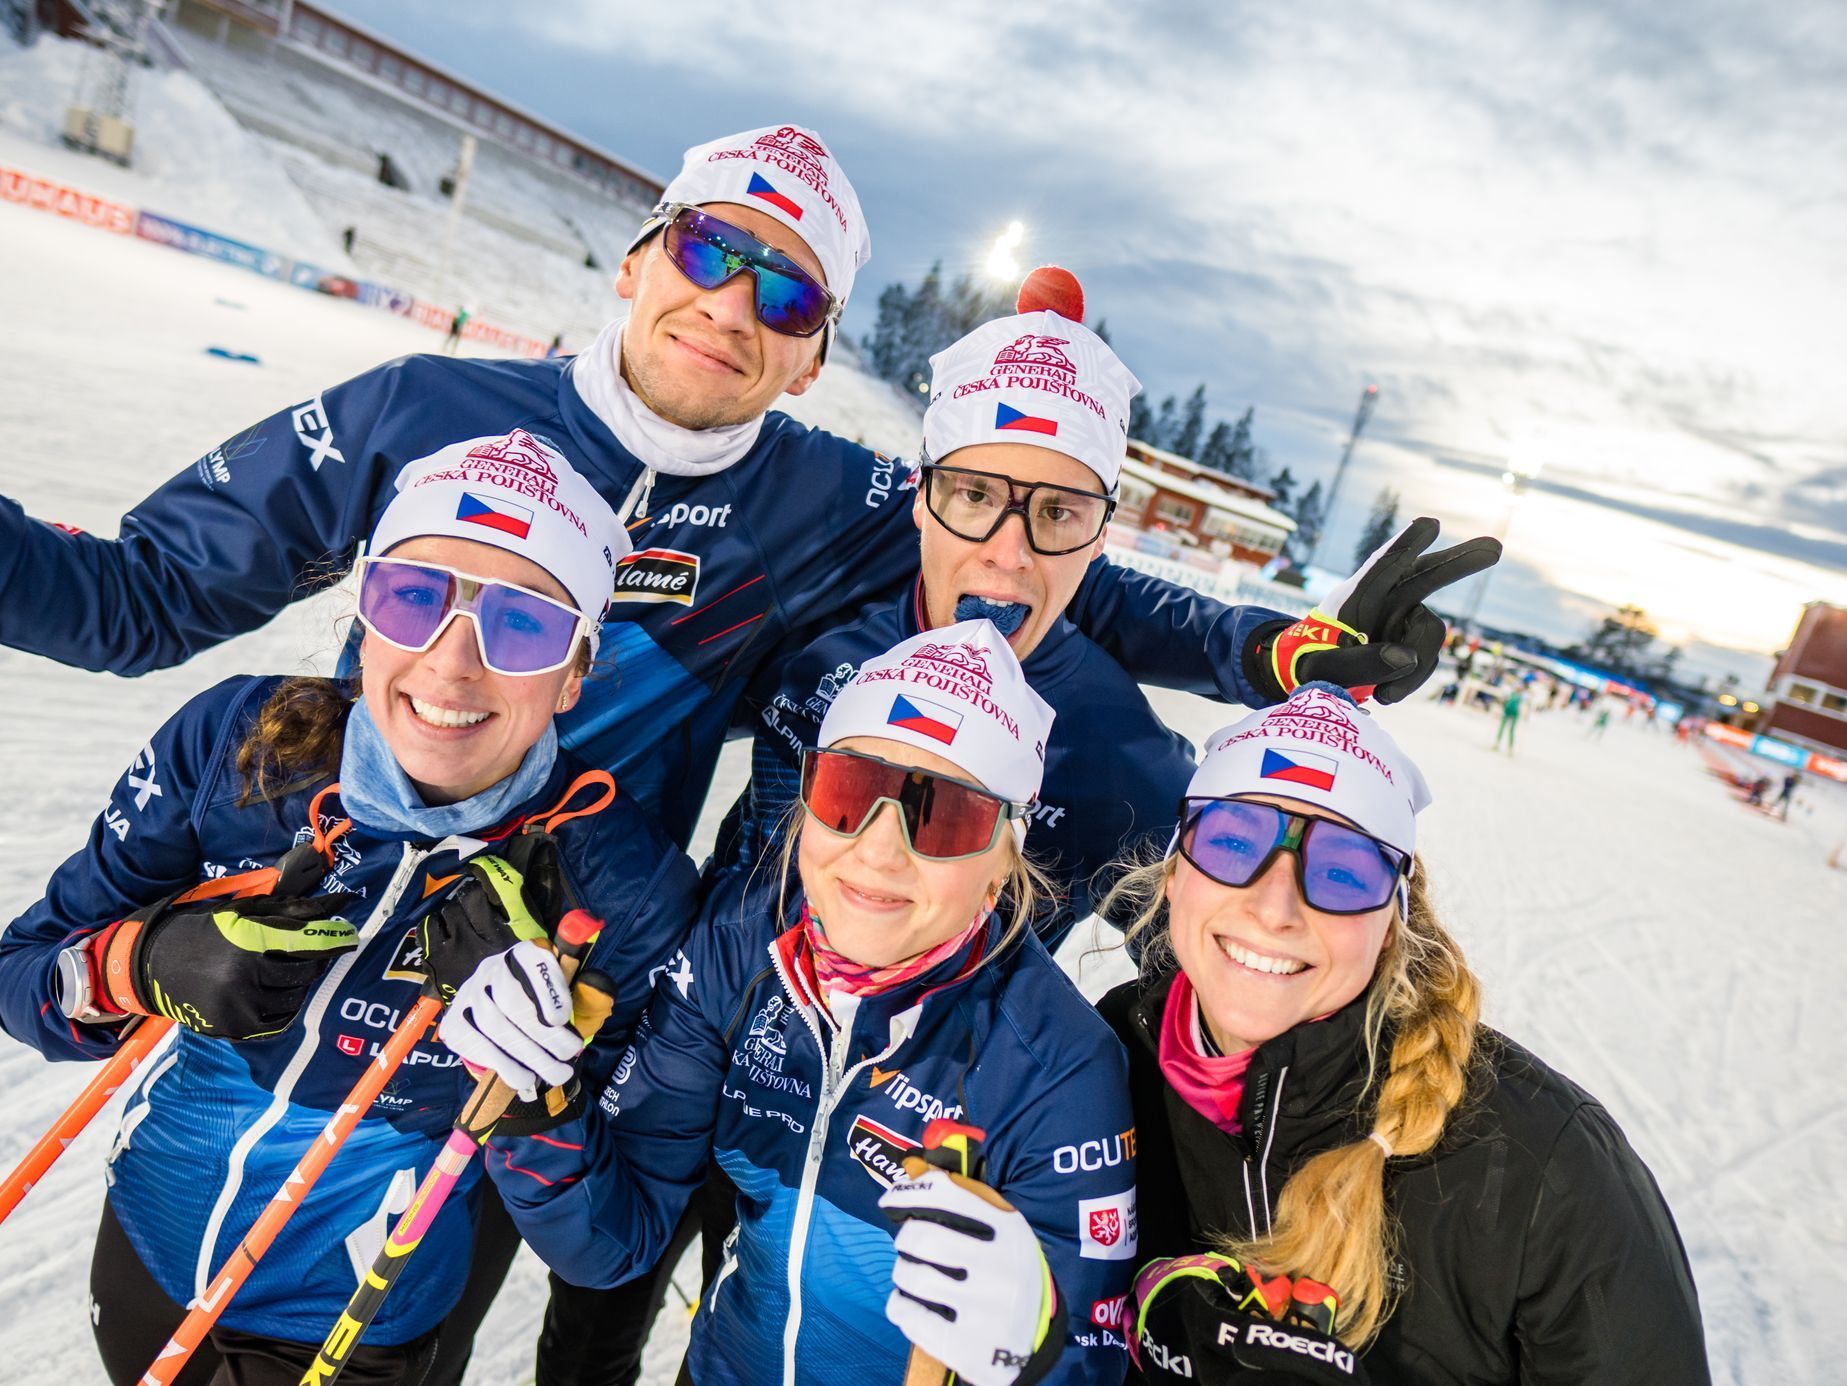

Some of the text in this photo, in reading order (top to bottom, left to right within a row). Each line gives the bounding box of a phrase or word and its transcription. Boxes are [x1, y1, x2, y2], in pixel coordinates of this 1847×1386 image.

[990, 364, 1077, 386] GENERALI
[460, 459, 557, 497] GENERALI
[901, 659, 992, 697] GENERALI
[1261, 718, 1358, 744] GENERALI
